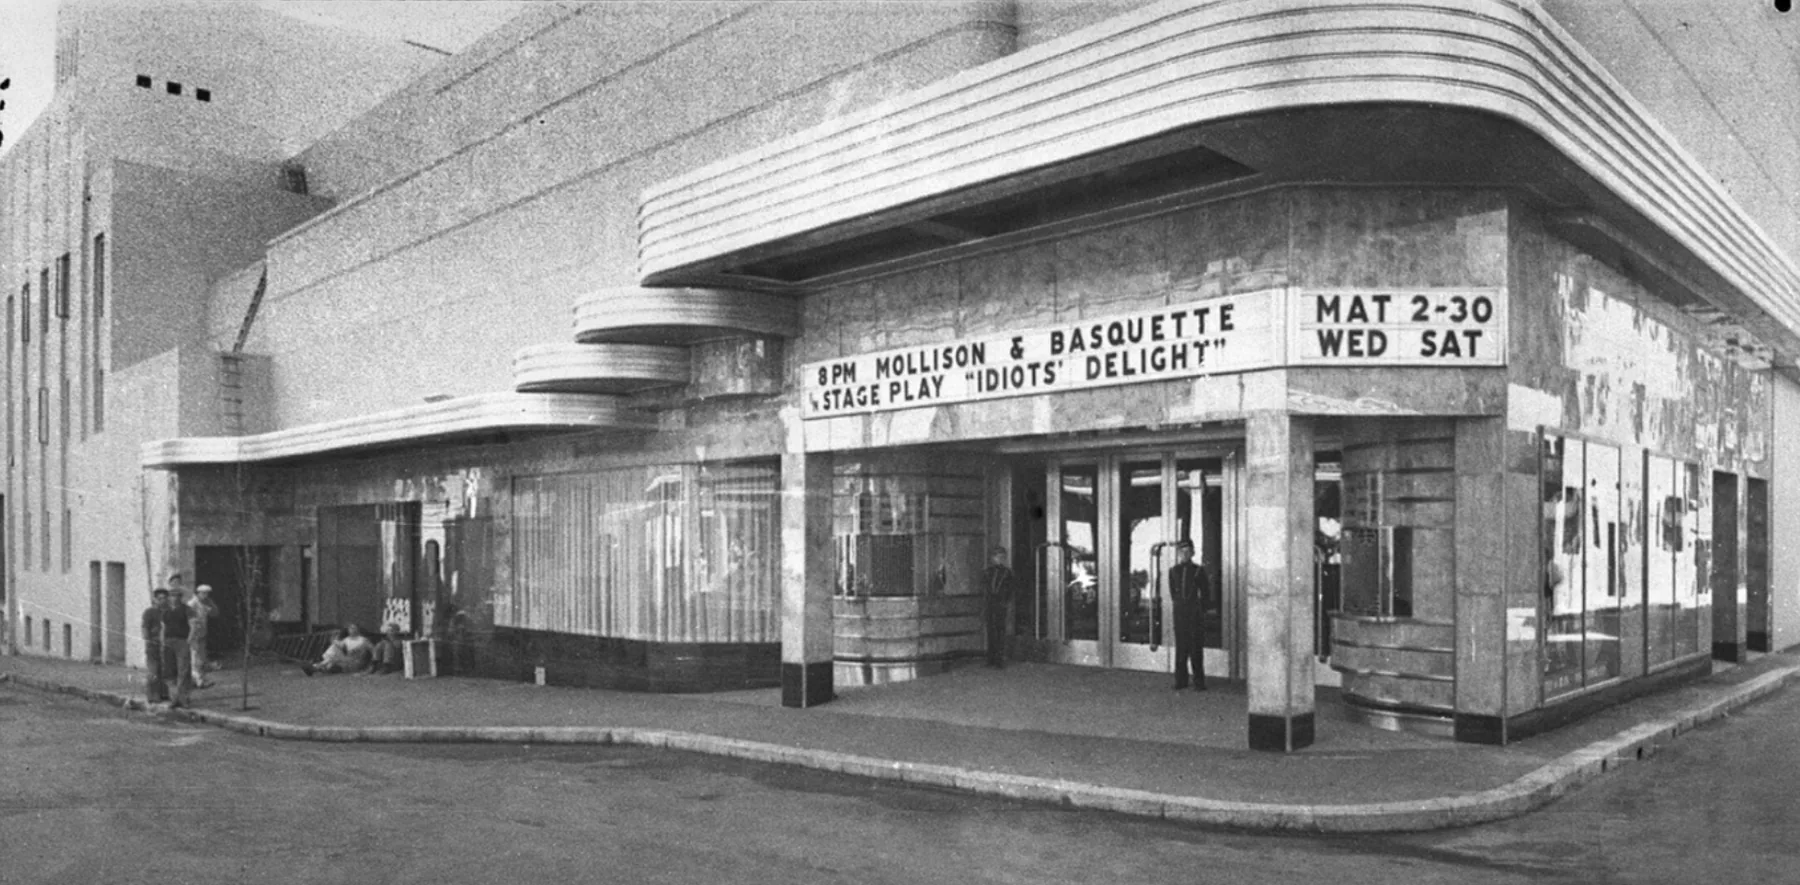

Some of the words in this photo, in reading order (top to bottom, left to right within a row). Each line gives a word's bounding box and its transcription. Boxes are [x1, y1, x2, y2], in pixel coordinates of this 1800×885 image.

[1316, 294, 1391, 323] MAT
[1411, 294, 1493, 323] 2-30
[876, 342, 986, 380] MOLLISON
[1010, 336, 1024, 360] &
[1050, 303, 1234, 356] BASQUETTE
[1316, 329, 1388, 357] WED
[1420, 329, 1483, 358] SAT
[823, 384, 880, 411] STAGE
[889, 374, 944, 403] PLAY
